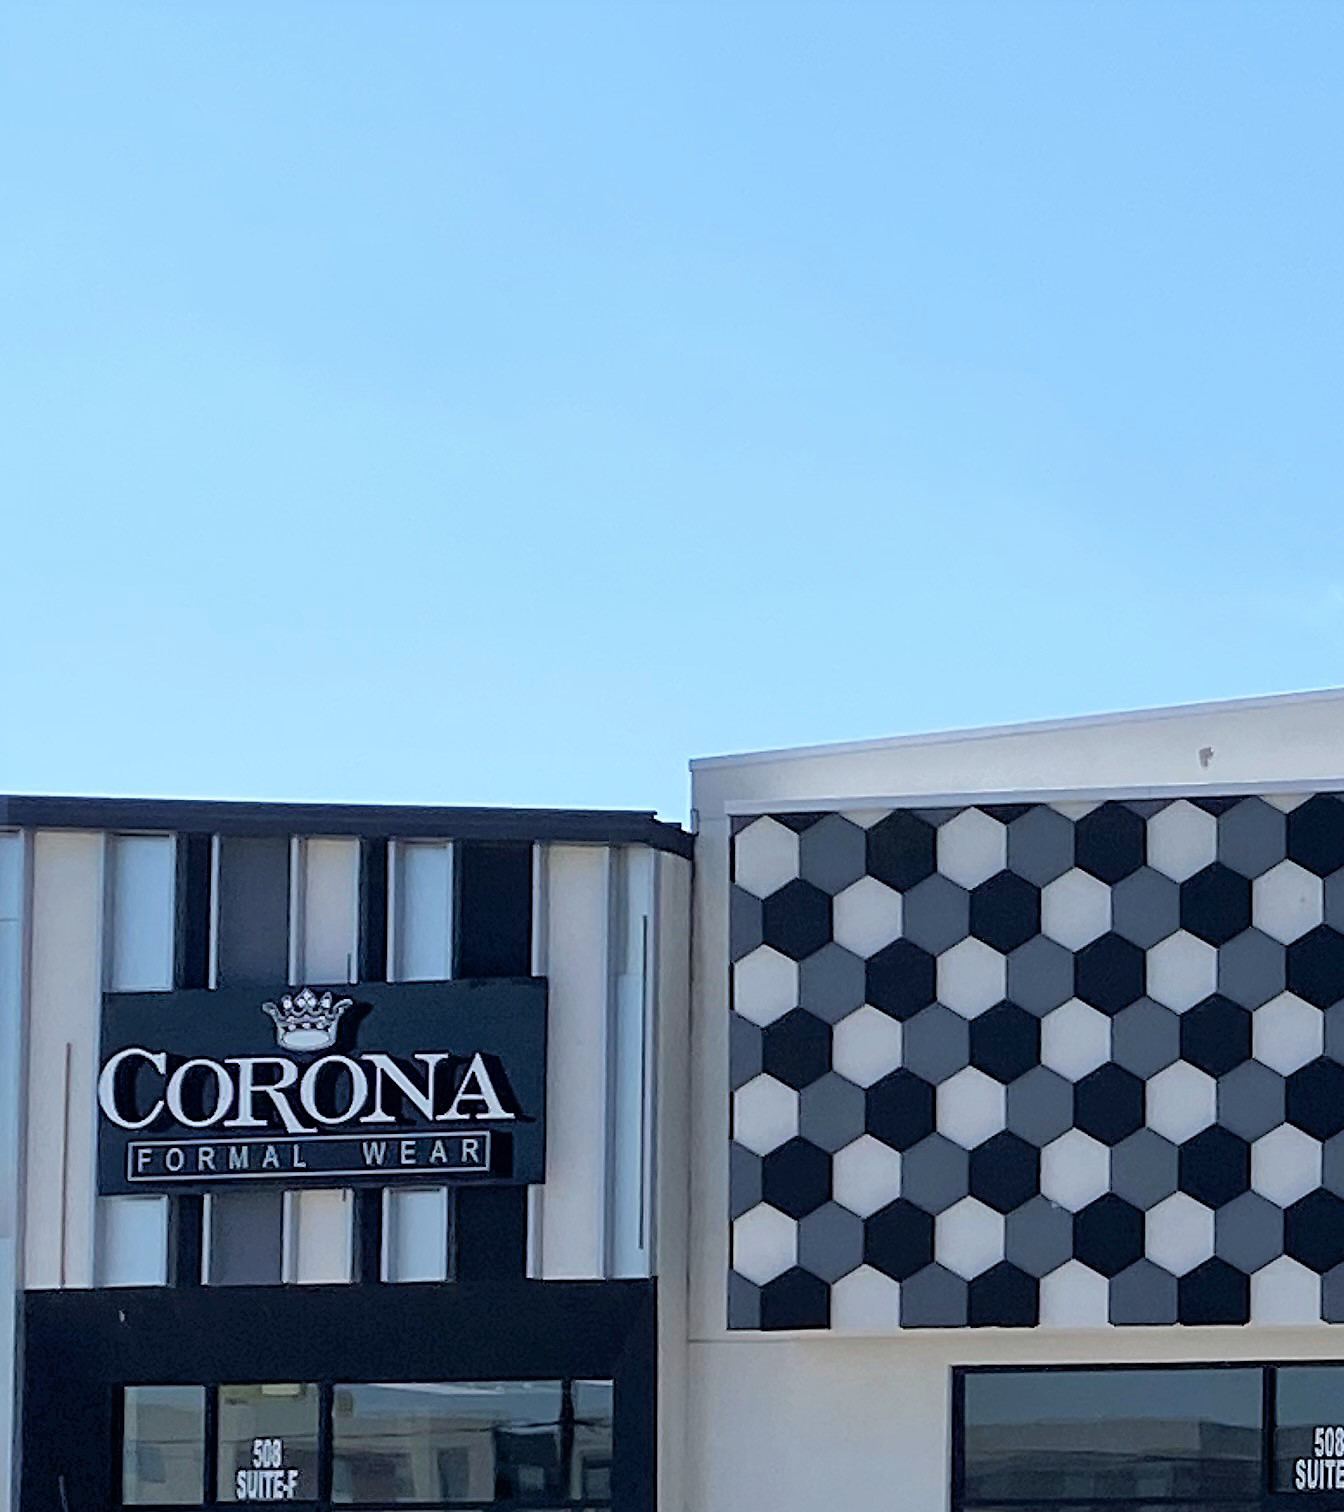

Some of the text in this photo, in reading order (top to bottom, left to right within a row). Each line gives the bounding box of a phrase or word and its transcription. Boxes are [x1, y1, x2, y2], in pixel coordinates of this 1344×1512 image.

[98, 1047, 515, 1133] CORONA
[137, 1138, 479, 1173] FORMAL WEAR
[253, 1439, 281, 1469] 508
[236, 1469, 298, 1499] SUITE-F
